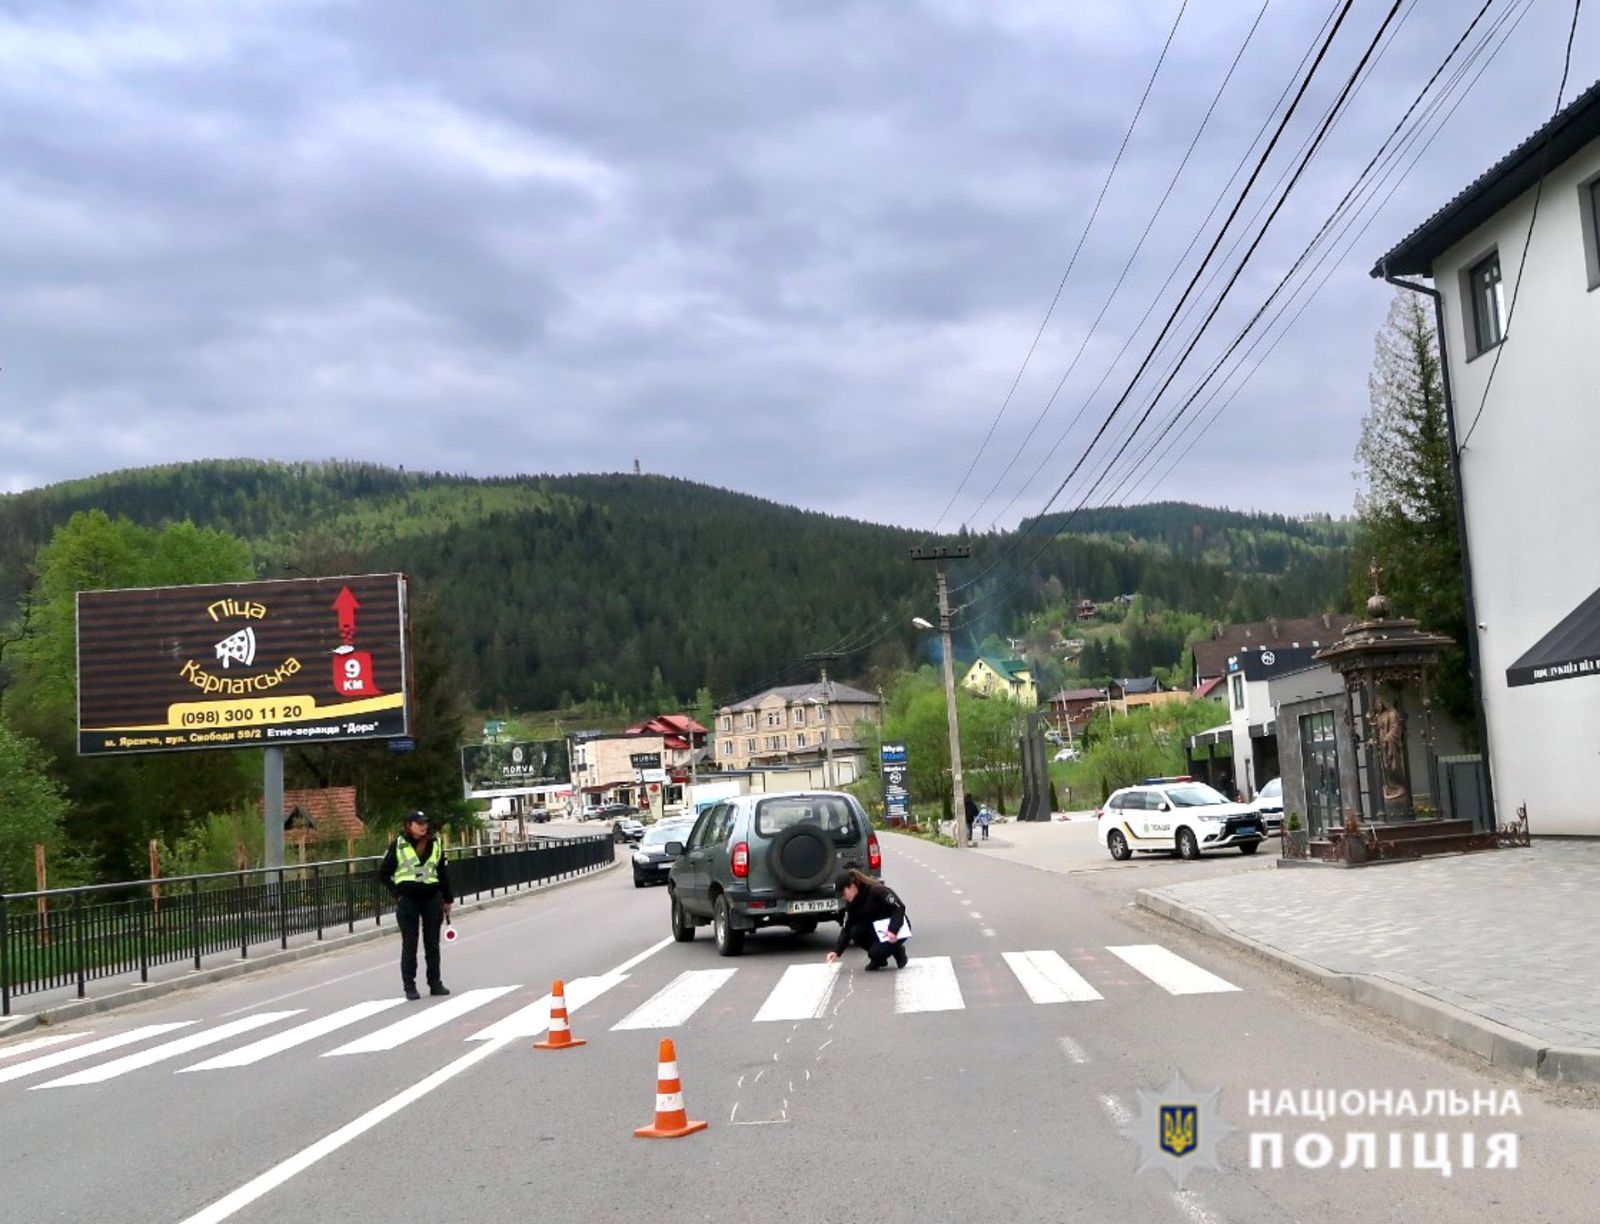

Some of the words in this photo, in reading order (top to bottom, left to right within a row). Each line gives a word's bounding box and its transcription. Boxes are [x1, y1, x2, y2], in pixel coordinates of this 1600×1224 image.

[207, 598, 267, 622] Піца
[179, 657, 302, 694] Карпатська
[344, 659, 361, 678] 9
[181, 710, 220, 727] (098)
[224, 708, 254, 722] 300
[259, 706, 276, 719] 11
[283, 705, 302, 718] 20
